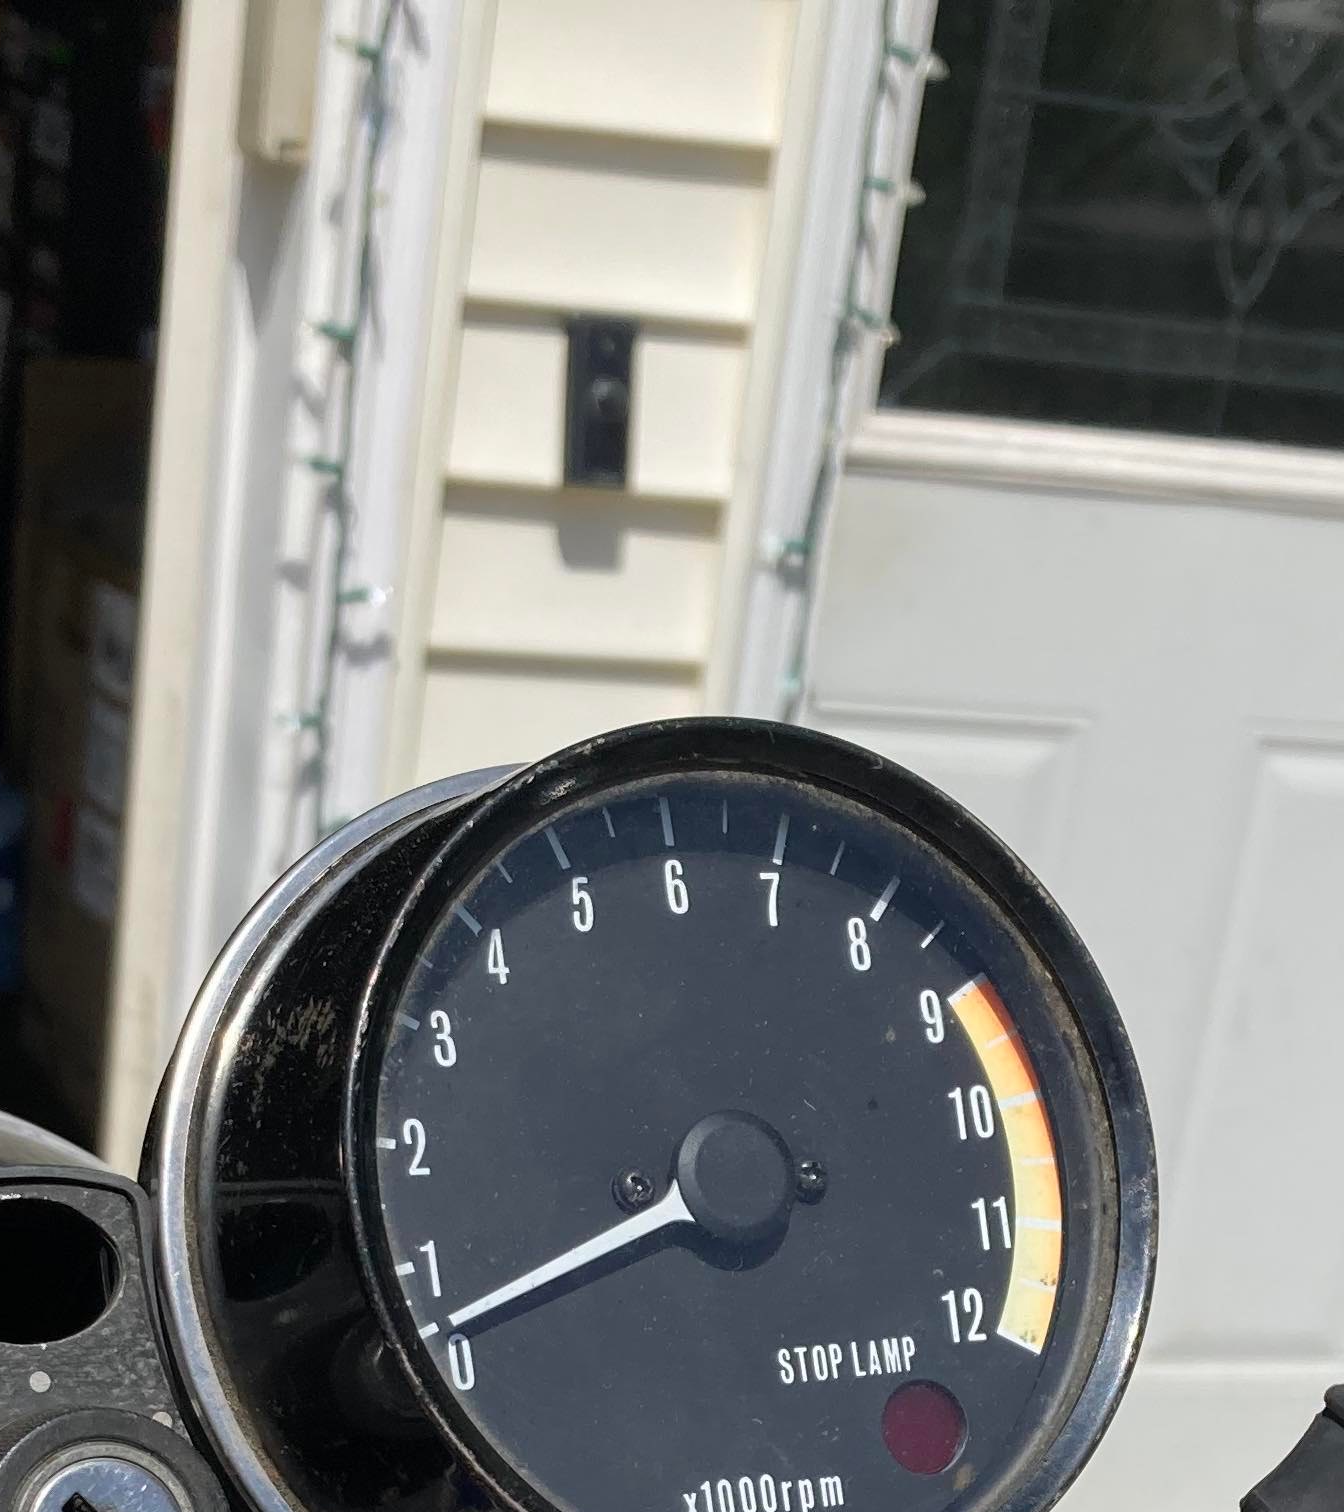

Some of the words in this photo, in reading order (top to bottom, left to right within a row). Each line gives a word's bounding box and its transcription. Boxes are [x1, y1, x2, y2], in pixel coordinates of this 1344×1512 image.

[573, 877, 593, 931] 5
[665, 860, 688, 914] 6
[760, 873, 779, 926] 7
[488, 929, 509, 984] 4
[848, 918, 871, 970] 8
[431, 1011, 456, 1066] 3
[920, 990, 944, 1043] 9
[948, 1085, 994, 1139] 10
[403, 1119, 430, 1175] 2
[972, 1196, 1011, 1250] 11
[420, 1241, 441, 1296] 1
[942, 1288, 986, 1342] 12
[447, 1332, 476, 1391] 0
[778, 1344, 842, 1383] STOP
[851, 1337, 915, 1376] LAMP
